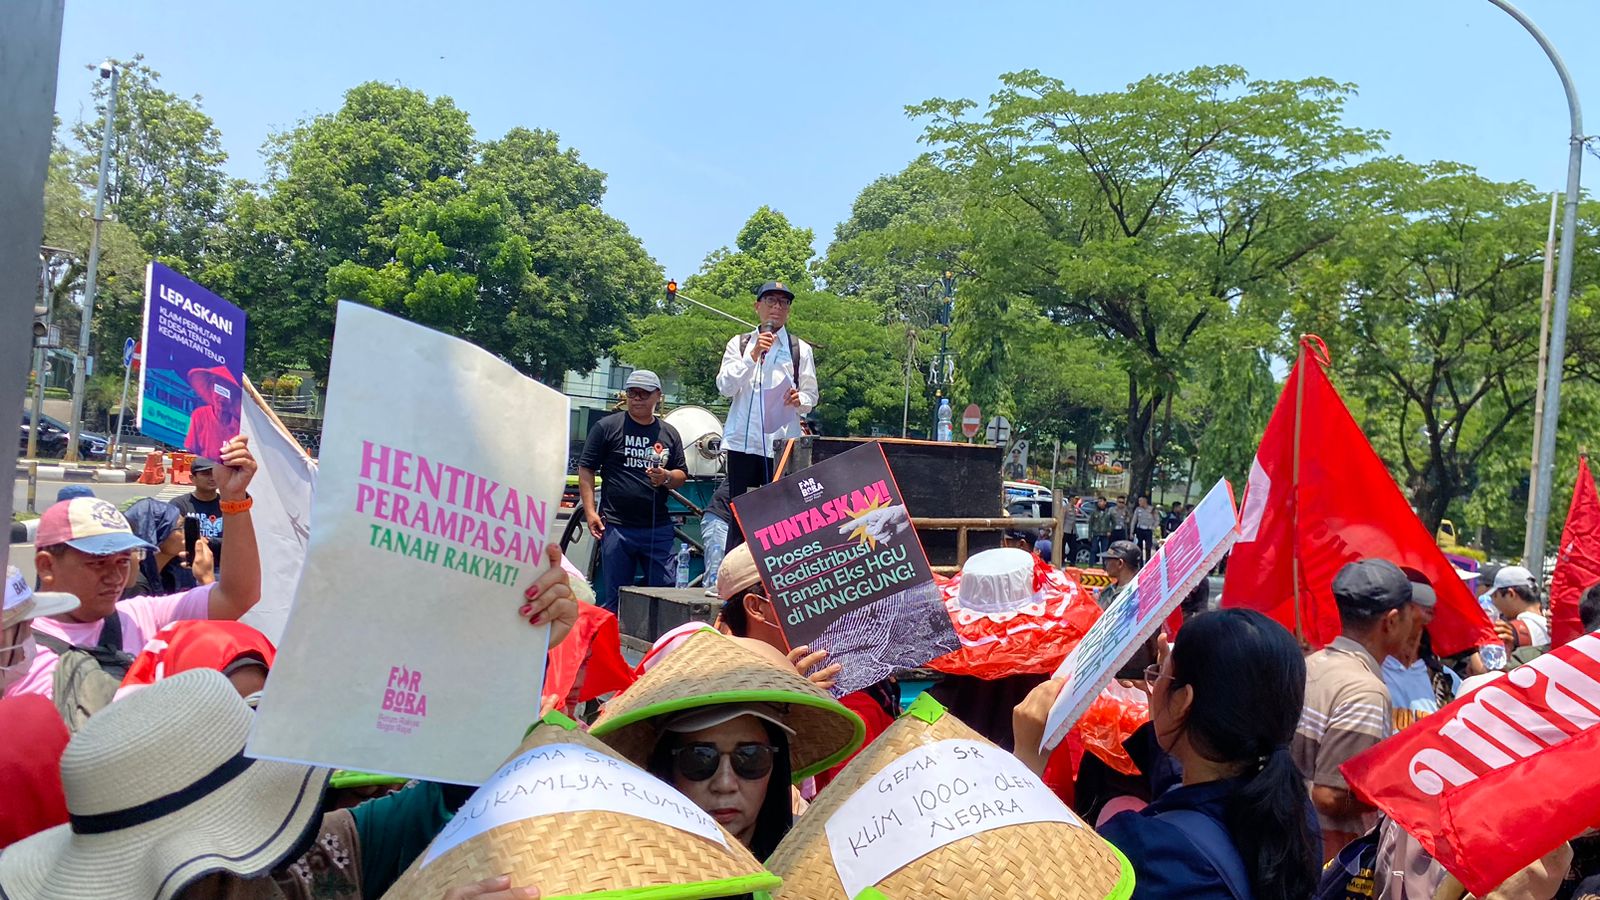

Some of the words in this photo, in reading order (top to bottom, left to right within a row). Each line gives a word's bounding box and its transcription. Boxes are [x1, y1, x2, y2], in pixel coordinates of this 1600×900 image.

[160, 284, 233, 336] LEPASKAN!
[160, 306, 181, 323] KLAIM
[182, 317, 221, 344] PERHUTANI
[159, 315, 168, 325] DI
[168, 320, 186, 336] DESA
[188, 330, 210, 347] TENJO
[159, 325, 203, 354] KECAMATAN
[204, 349, 226, 364] TENJO
[624, 447, 644, 458] FOR
[625, 435, 650, 447] MAP
[359, 440, 547, 536] HENTIKAN
[801, 482, 824, 497] BORA
[356, 483, 544, 568] PERAMPASAN
[754, 480, 892, 551] TUNTASKAN!
[370, 524, 440, 564] TANAH
[442, 547, 520, 587] RAKYAT!
[764, 540, 823, 572] Proses
[771, 542, 871, 590] Redistribusi
[778, 577, 834, 608] Tanah
[833, 564, 865, 586] Eks
[865, 544, 907, 573] HGU
[787, 610, 805, 625] di
[805, 562, 916, 619] NANGGUNG!
[382, 688, 427, 717] BORA
[499, 749, 566, 778] GEMA
[878, 756, 937, 794] GEMA
[994, 772, 1035, 792] OLEH
